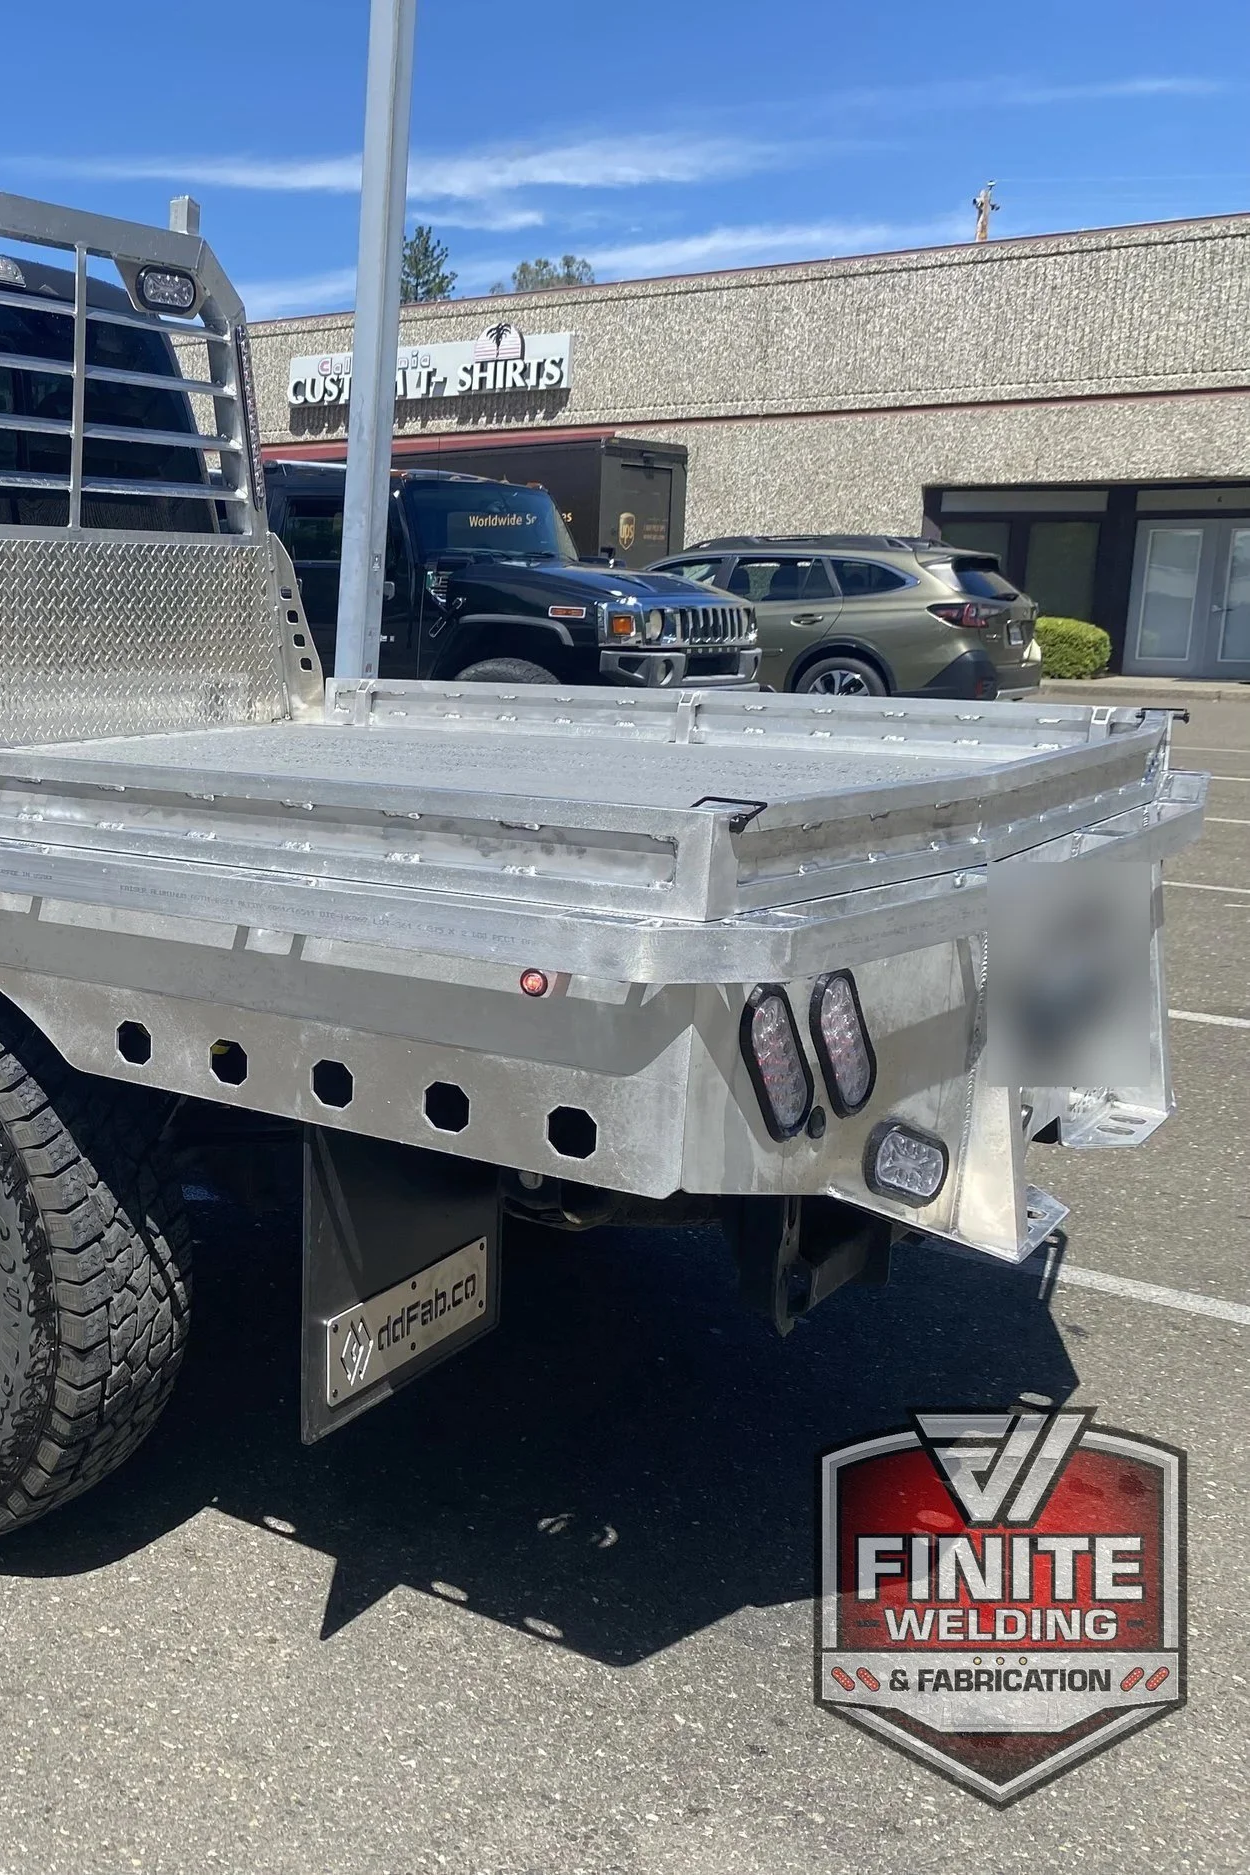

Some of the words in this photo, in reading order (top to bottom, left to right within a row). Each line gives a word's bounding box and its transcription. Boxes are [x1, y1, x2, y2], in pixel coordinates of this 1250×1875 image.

[318, 351, 430, 376] Calnia
[456, 357, 564, 392] SHIRTS
[469, 513, 523, 528] Worldwide
[620, 523, 635, 545] ups
[377, 1273, 476, 1351] ddFab.co
